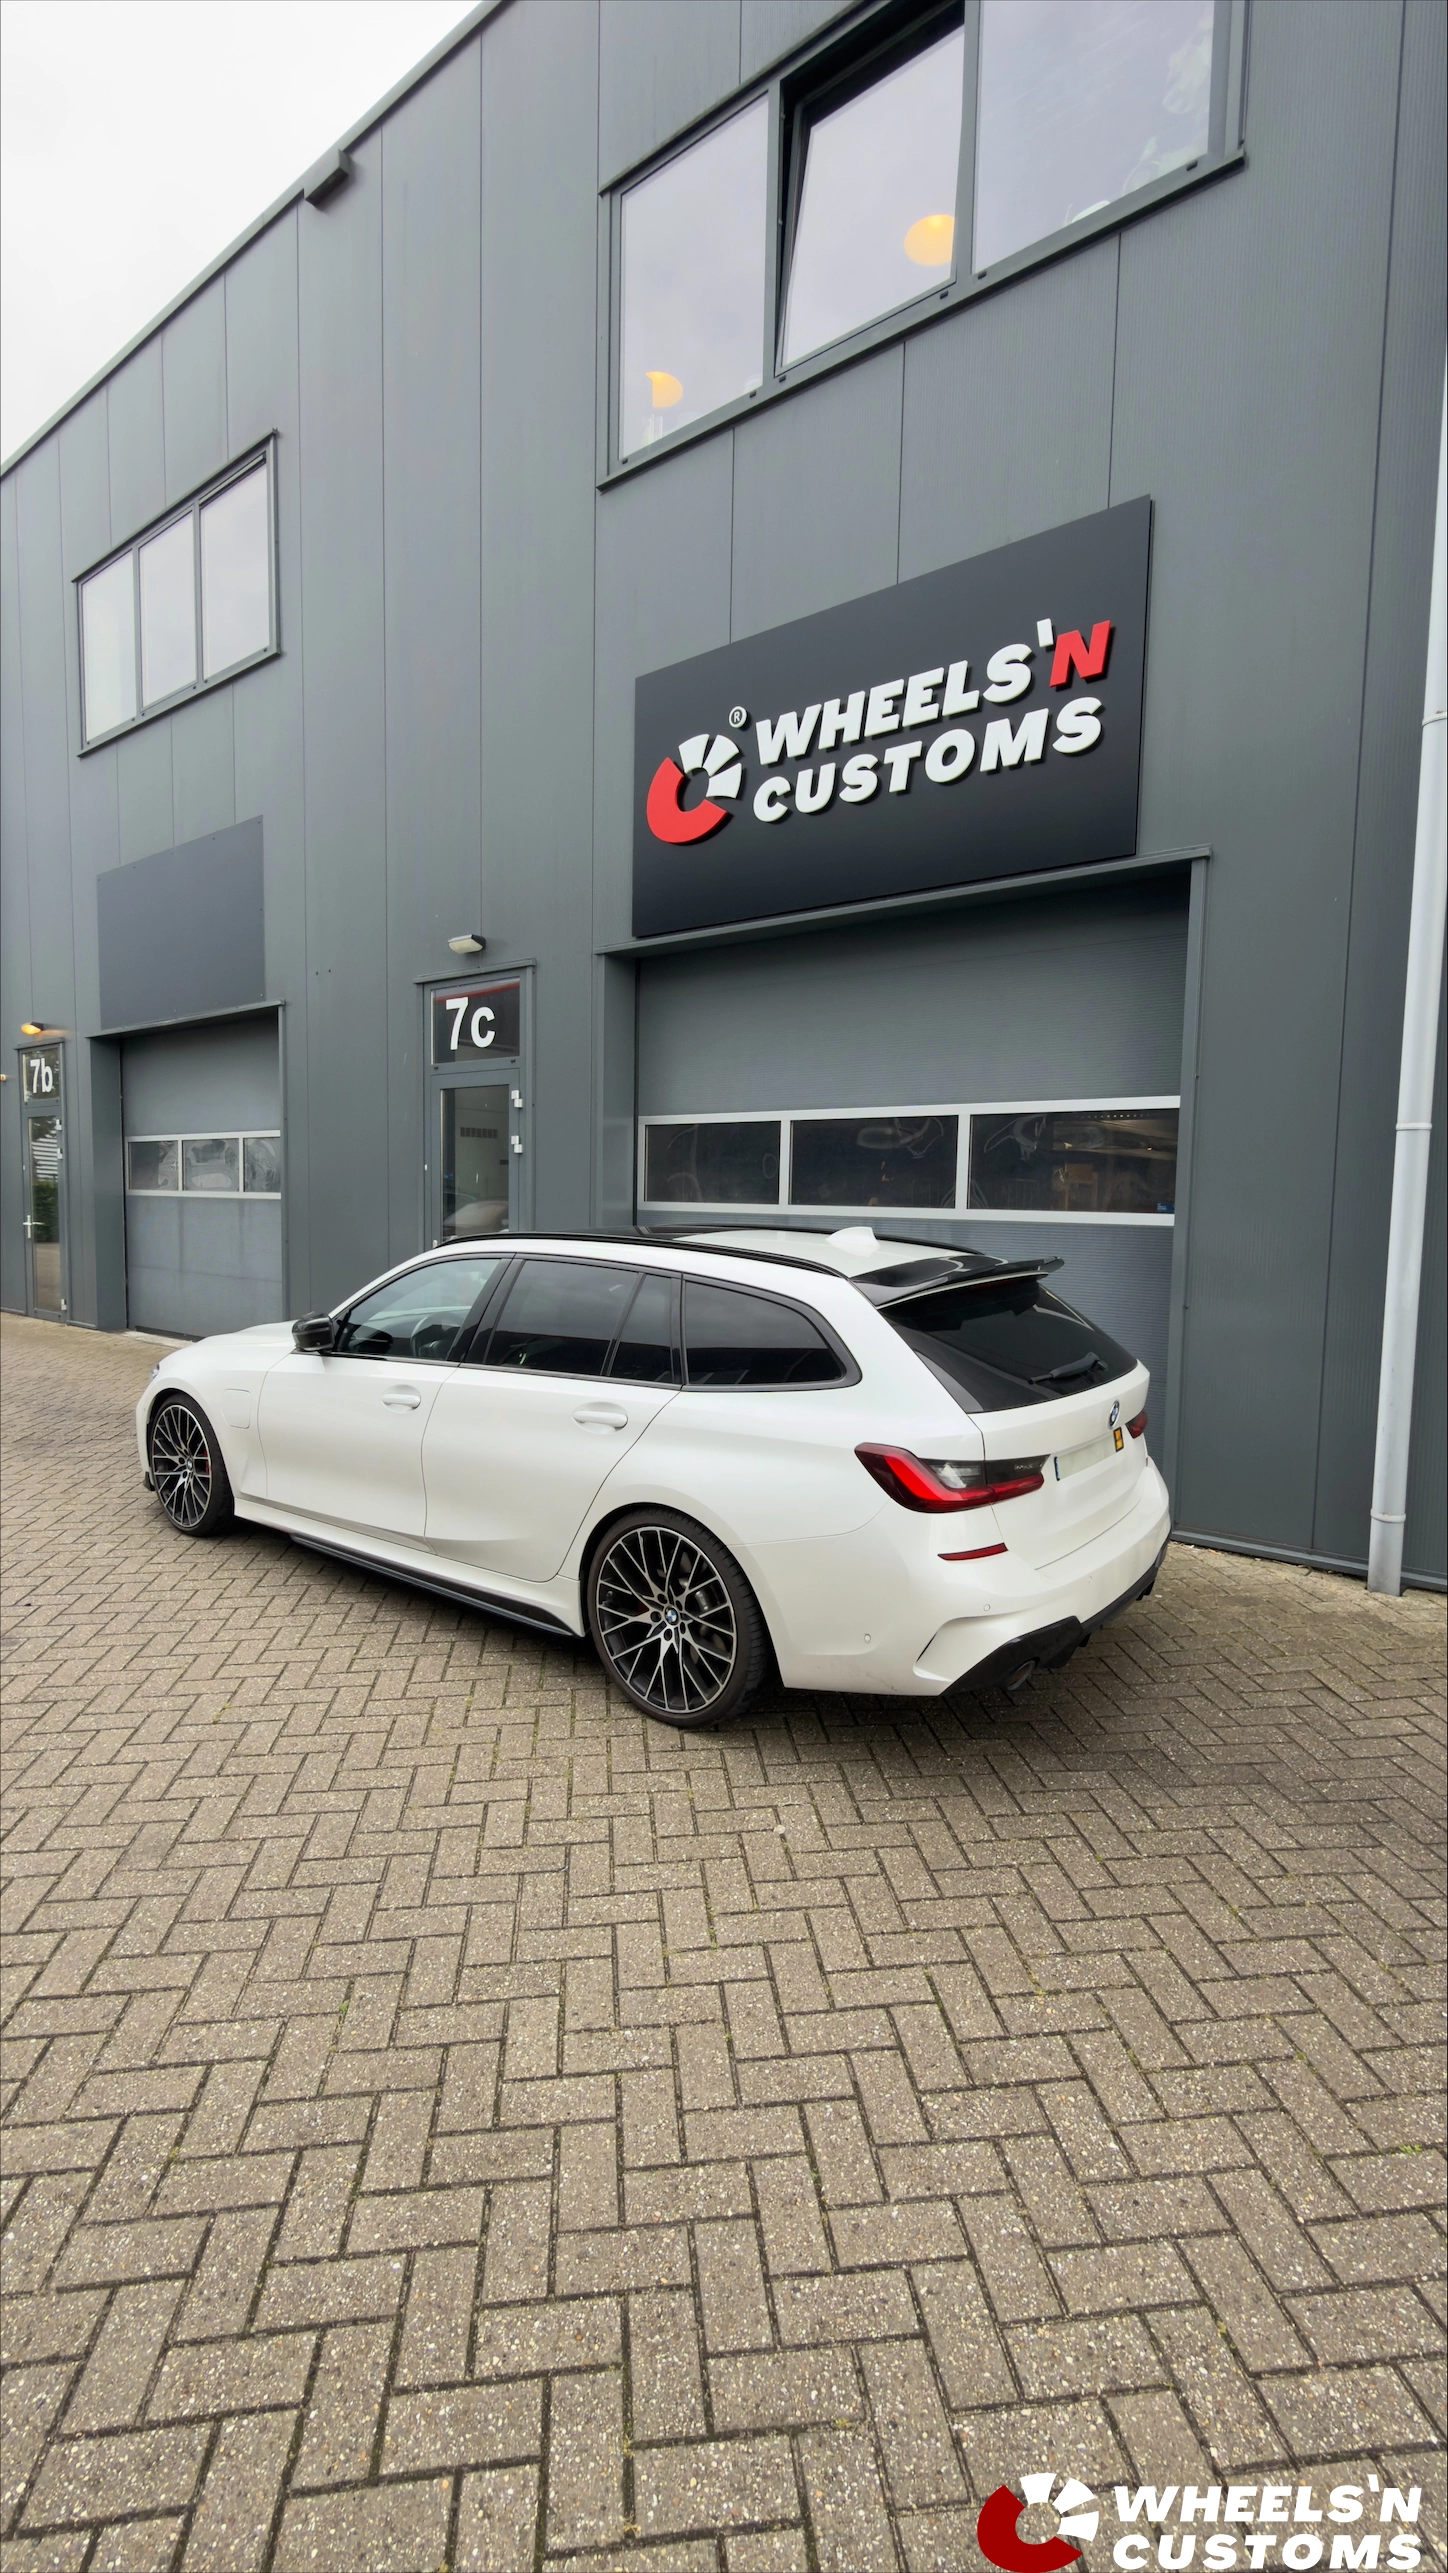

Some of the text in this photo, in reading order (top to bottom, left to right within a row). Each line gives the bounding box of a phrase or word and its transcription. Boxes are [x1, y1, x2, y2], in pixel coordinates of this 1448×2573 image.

[753, 697, 1102, 822] CUSTOMS
[446, 996, 495, 1051] 7c
[30, 1057, 53, 1094] 7b
